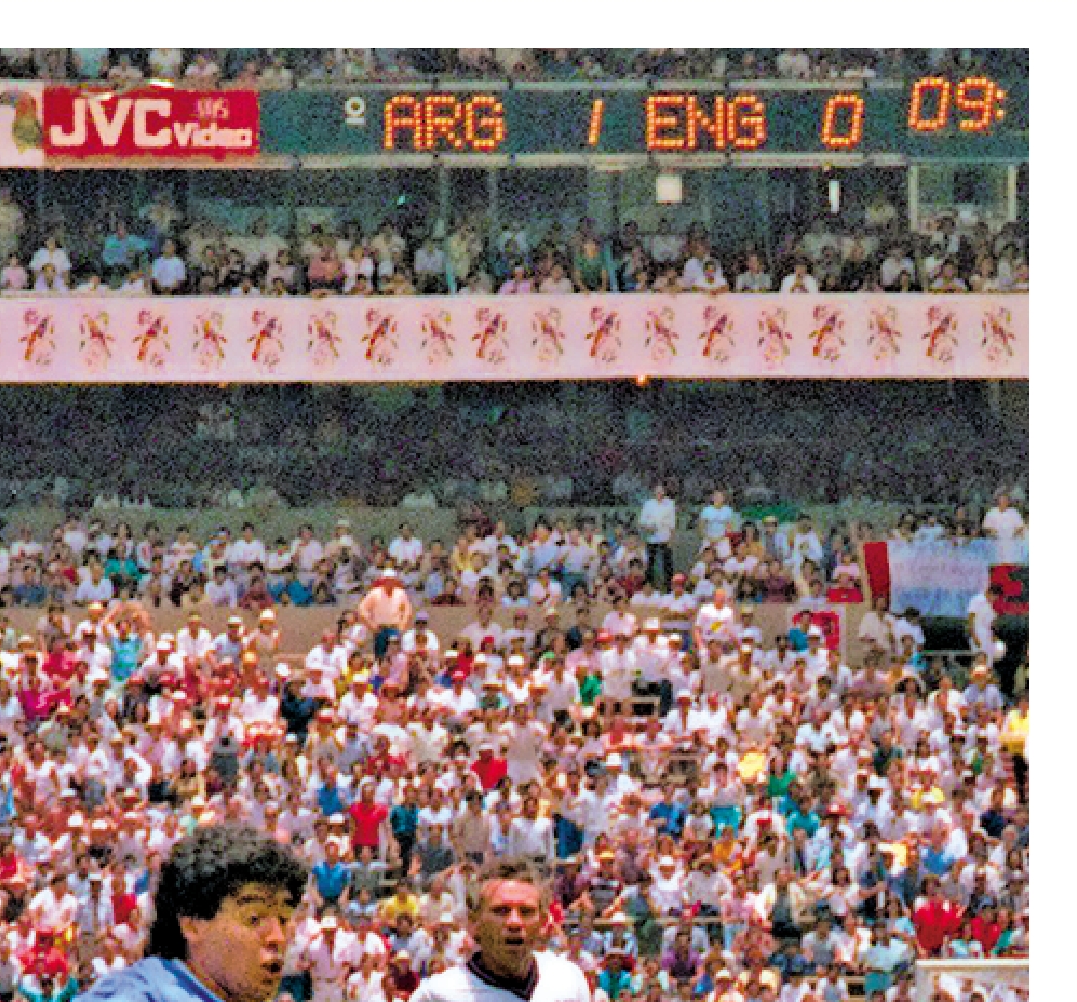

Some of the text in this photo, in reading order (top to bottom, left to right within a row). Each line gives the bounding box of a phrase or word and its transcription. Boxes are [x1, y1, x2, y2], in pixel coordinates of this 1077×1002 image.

[50, 98, 172, 147] JVC
[383, 95, 505, 150] ARG
[589, 99, 604, 145] 1
[645, 95, 768, 150] ENG
[821, 94, 865, 148] 0
